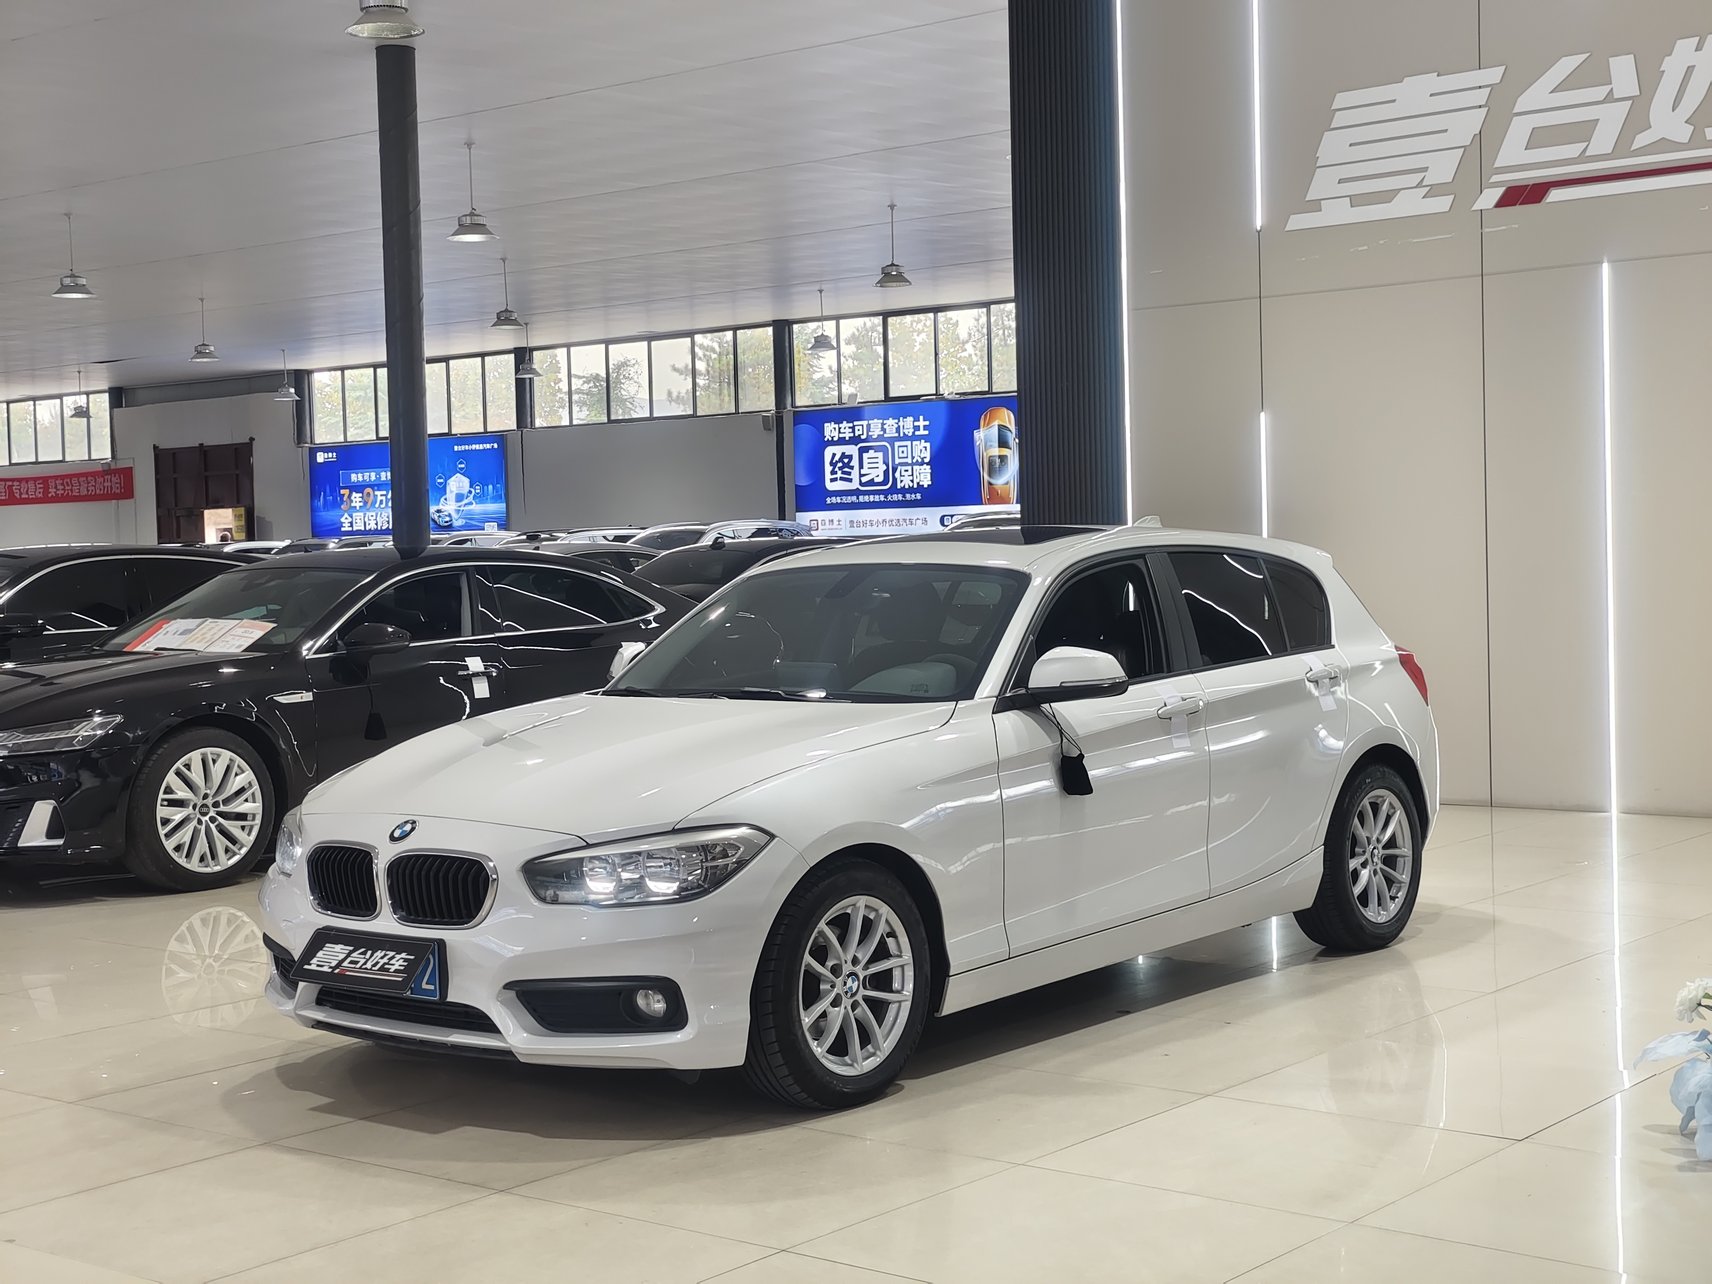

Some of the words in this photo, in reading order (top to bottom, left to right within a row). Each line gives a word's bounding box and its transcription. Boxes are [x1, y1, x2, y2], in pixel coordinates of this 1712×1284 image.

[824, 415, 930, 442] 购车可享查博士
[894, 440, 931, 464] 回购
[828, 449, 887, 484] 终身
[894, 465, 932, 489] 保障
[340, 511, 393, 532] 全国保修
[303, 943, 416, 973] 壹台好车
